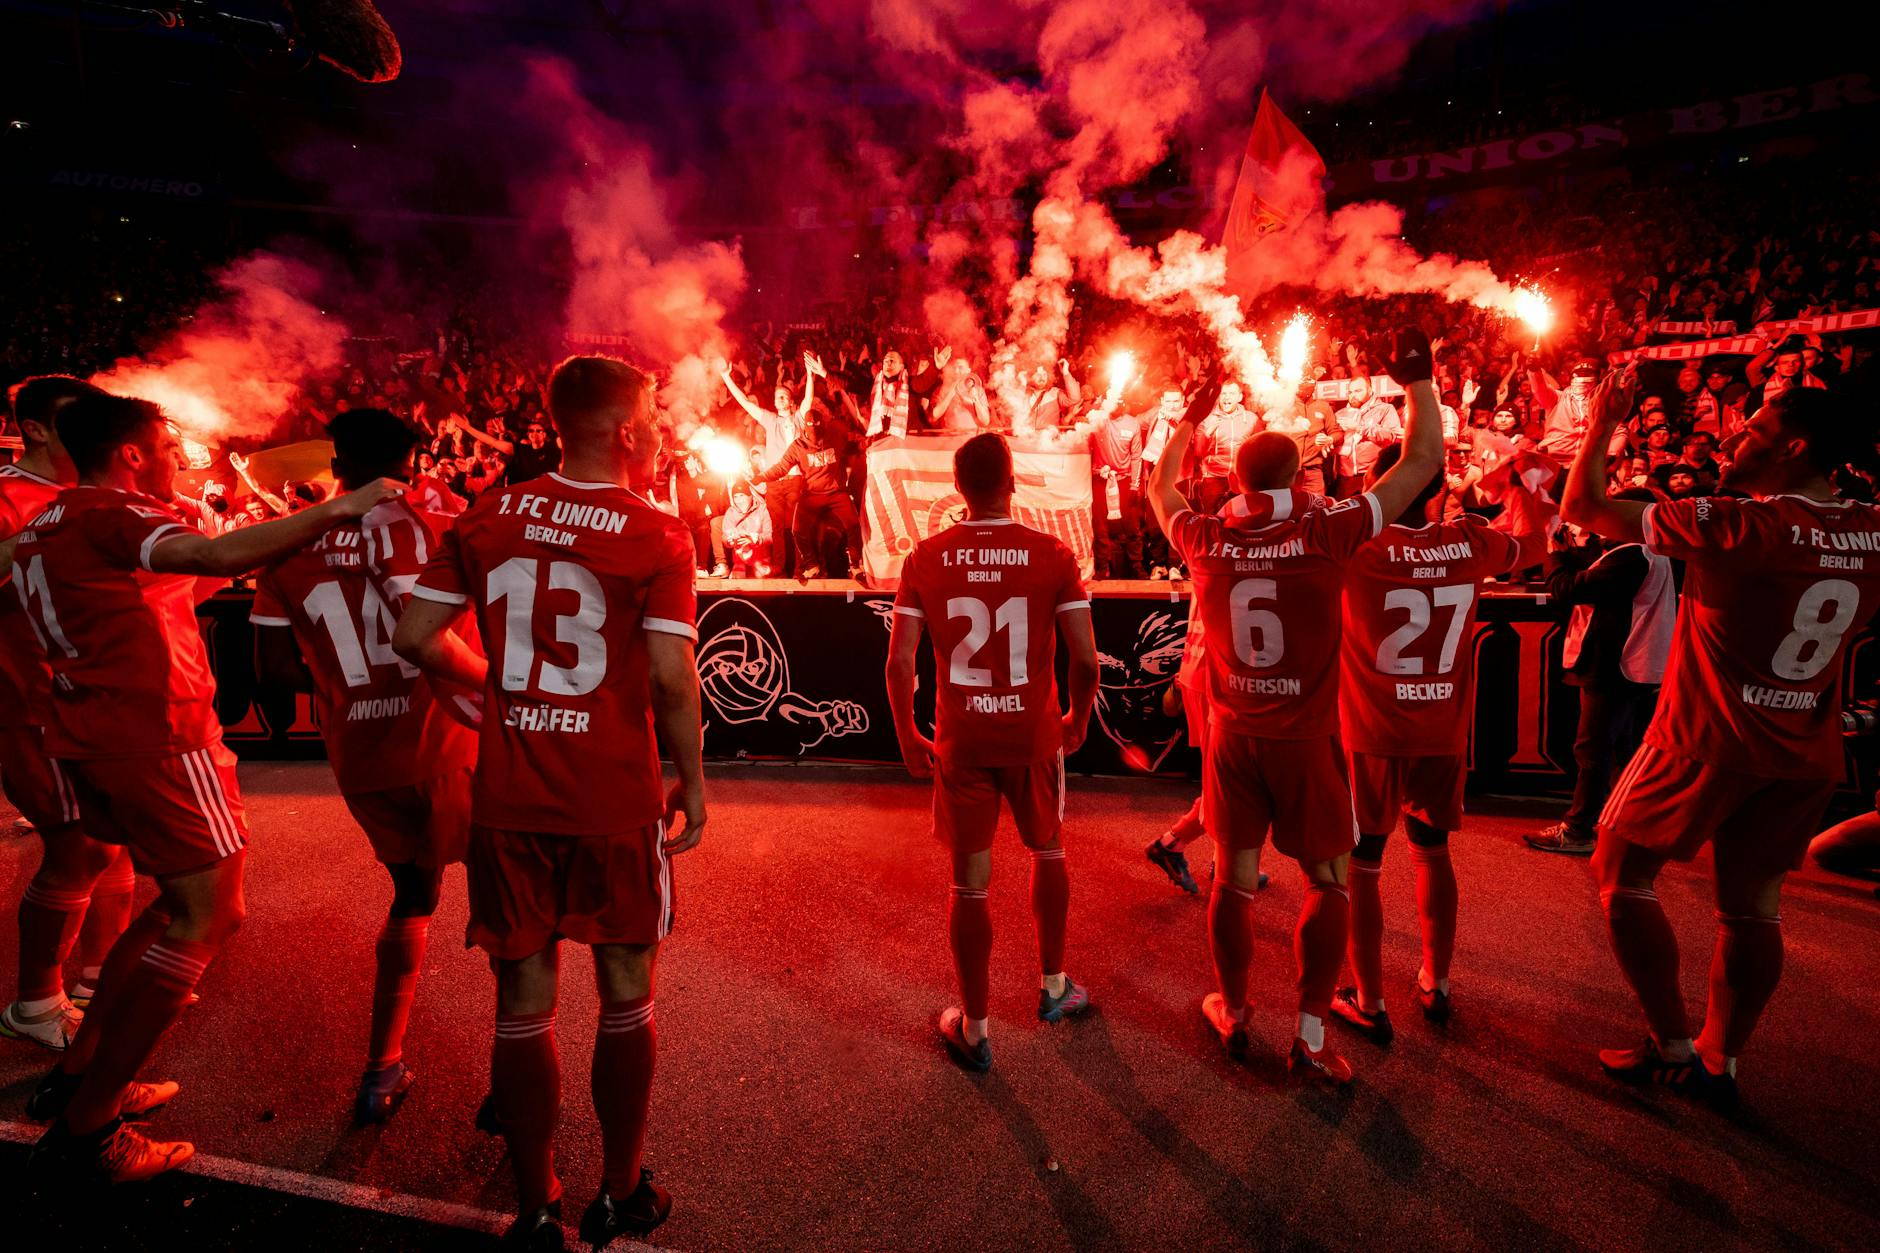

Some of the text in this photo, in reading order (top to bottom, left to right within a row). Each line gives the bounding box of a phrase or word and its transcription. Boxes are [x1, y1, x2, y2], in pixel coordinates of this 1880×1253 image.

[50, 168, 203, 197] AUTOHERO
[498, 493, 628, 534] 1. FC UNION
[524, 523, 578, 546] BERLIN
[1811, 528, 1830, 549] FC
[941, 549, 1029, 566] 1. FC UNION
[1221, 543, 1243, 559] FC
[1247, 538, 1305, 559] UNION
[1387, 542, 1473, 563] 1. FC UNION
[1235, 560, 1273, 572] BERLIN
[1412, 566, 1447, 579] BERLIN
[1819, 554, 1864, 571] BERLIN
[967, 571, 1002, 583] BERLIN
[303, 577, 421, 688] 14
[487, 558, 607, 696] 13
[1230, 578, 1284, 668] 6
[1376, 583, 1475, 675] 27
[1771, 579, 1860, 681] 8
[947, 597, 1029, 687] 21
[1228, 674, 1301, 696] RYERSON
[1396, 683, 1454, 701] BECKER
